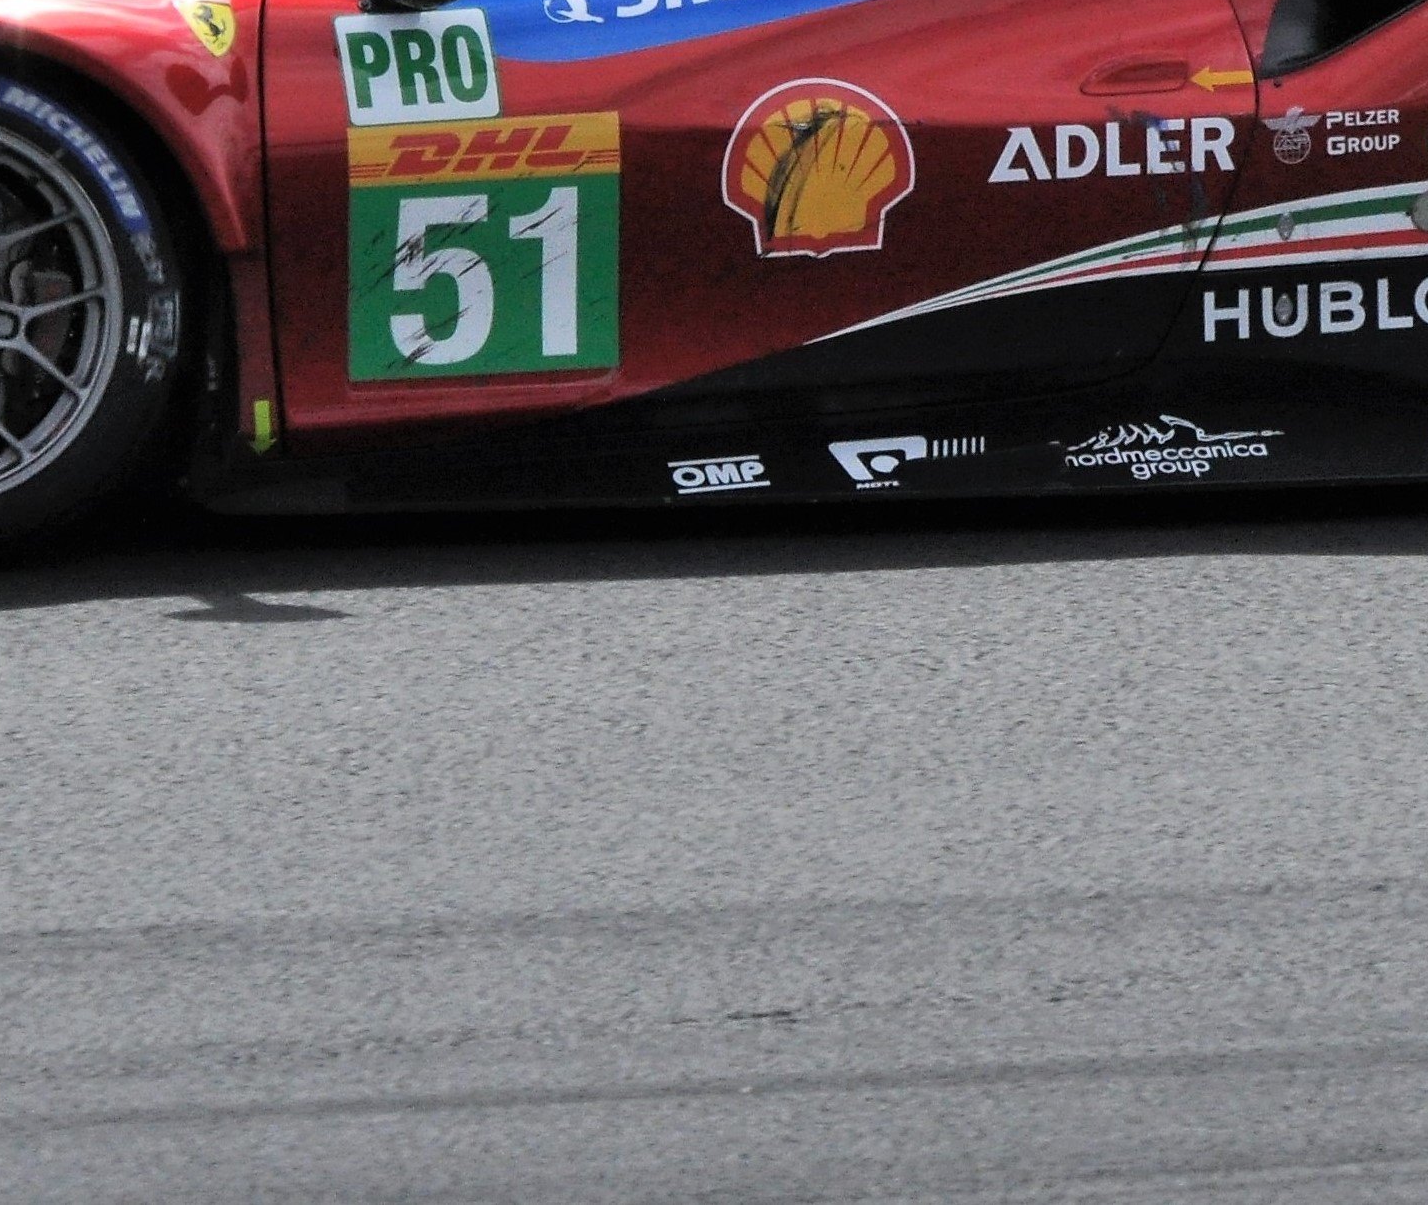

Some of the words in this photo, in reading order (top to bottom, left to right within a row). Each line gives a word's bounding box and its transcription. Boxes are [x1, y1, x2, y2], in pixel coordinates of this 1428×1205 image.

[345, 24, 489, 110] PRO
[1326, 108, 1400, 130] PELZER
[1, 85, 142, 220] MICHELIN
[386, 124, 589, 177] DHL
[987, 116, 1238, 184] ADLER
[1327, 134, 1401, 156] GROUP
[388, 186, 579, 366] 51
[672, 460, 766, 488] OMP
[1065, 440, 1269, 468] nordmeccanica
[1130, 459, 1212, 481] group
